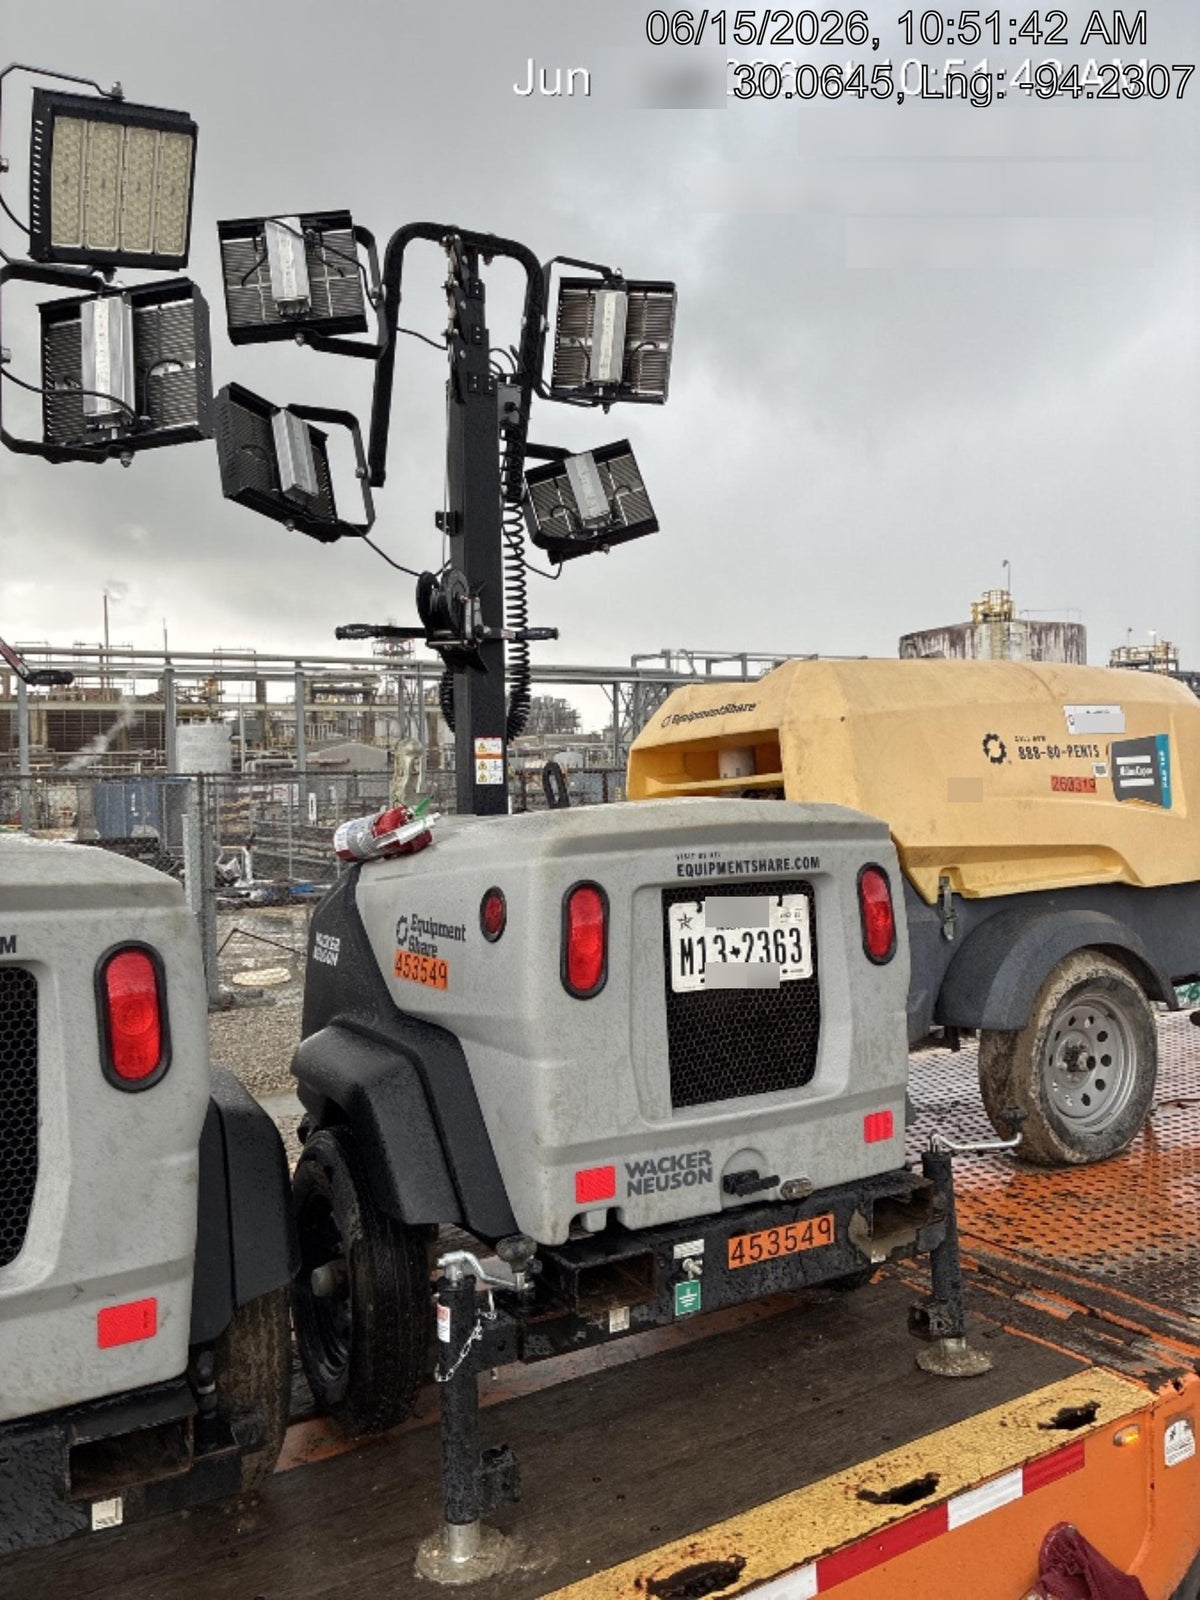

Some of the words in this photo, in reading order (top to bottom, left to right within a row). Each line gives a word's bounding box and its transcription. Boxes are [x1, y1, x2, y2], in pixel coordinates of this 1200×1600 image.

[676, 856, 821, 877] EQUIPMENTSHARE.COM
[411, 913, 466, 942] Equipment
[408, 935, 438, 958] Share
[395, 952, 448, 989] 453549
[624, 1150, 713, 1179] WACKER
[627, 1167, 713, 1197] NEUSON
[731, 1217, 831, 1264] 453549
